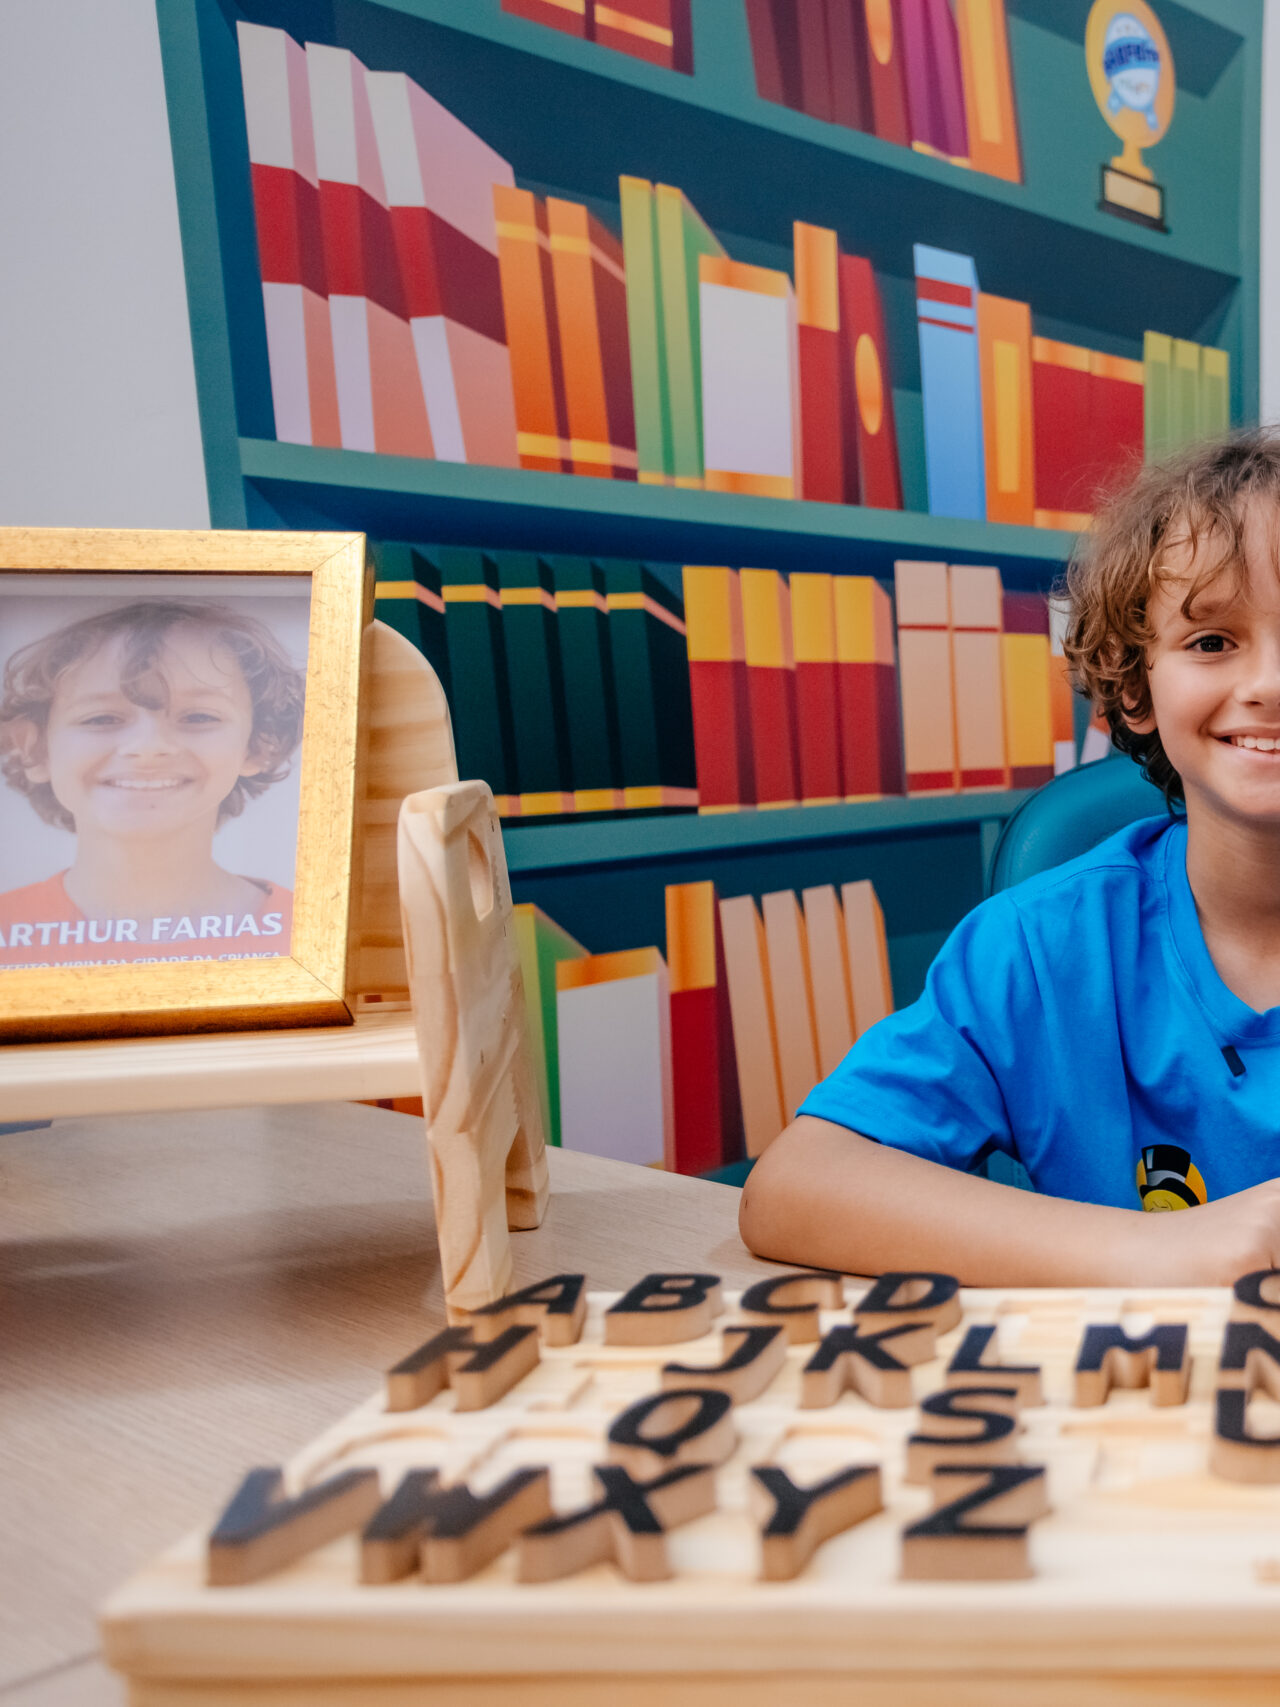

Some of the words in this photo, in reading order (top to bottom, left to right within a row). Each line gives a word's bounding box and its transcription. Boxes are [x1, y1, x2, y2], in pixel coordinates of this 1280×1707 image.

[151, 912, 283, 940] FARIAS
[464, 1273, 586, 1316] A
[605, 1273, 722, 1315] B
[740, 1272, 843, 1315] C
[852, 1271, 961, 1314] D
[385, 1325, 540, 1375] H
[662, 1325, 785, 1376] J
[802, 1322, 935, 1372] K
[946, 1325, 1041, 1374] L
[1076, 1323, 1190, 1372] M
[607, 1388, 734, 1457] Q
[907, 1386, 1018, 1446] S
[209, 1466, 380, 1546] V
[361, 1464, 551, 1542] W
[517, 1464, 716, 1537] X
[750, 1464, 881, 1539] Y
[903, 1464, 1046, 1539] Z
